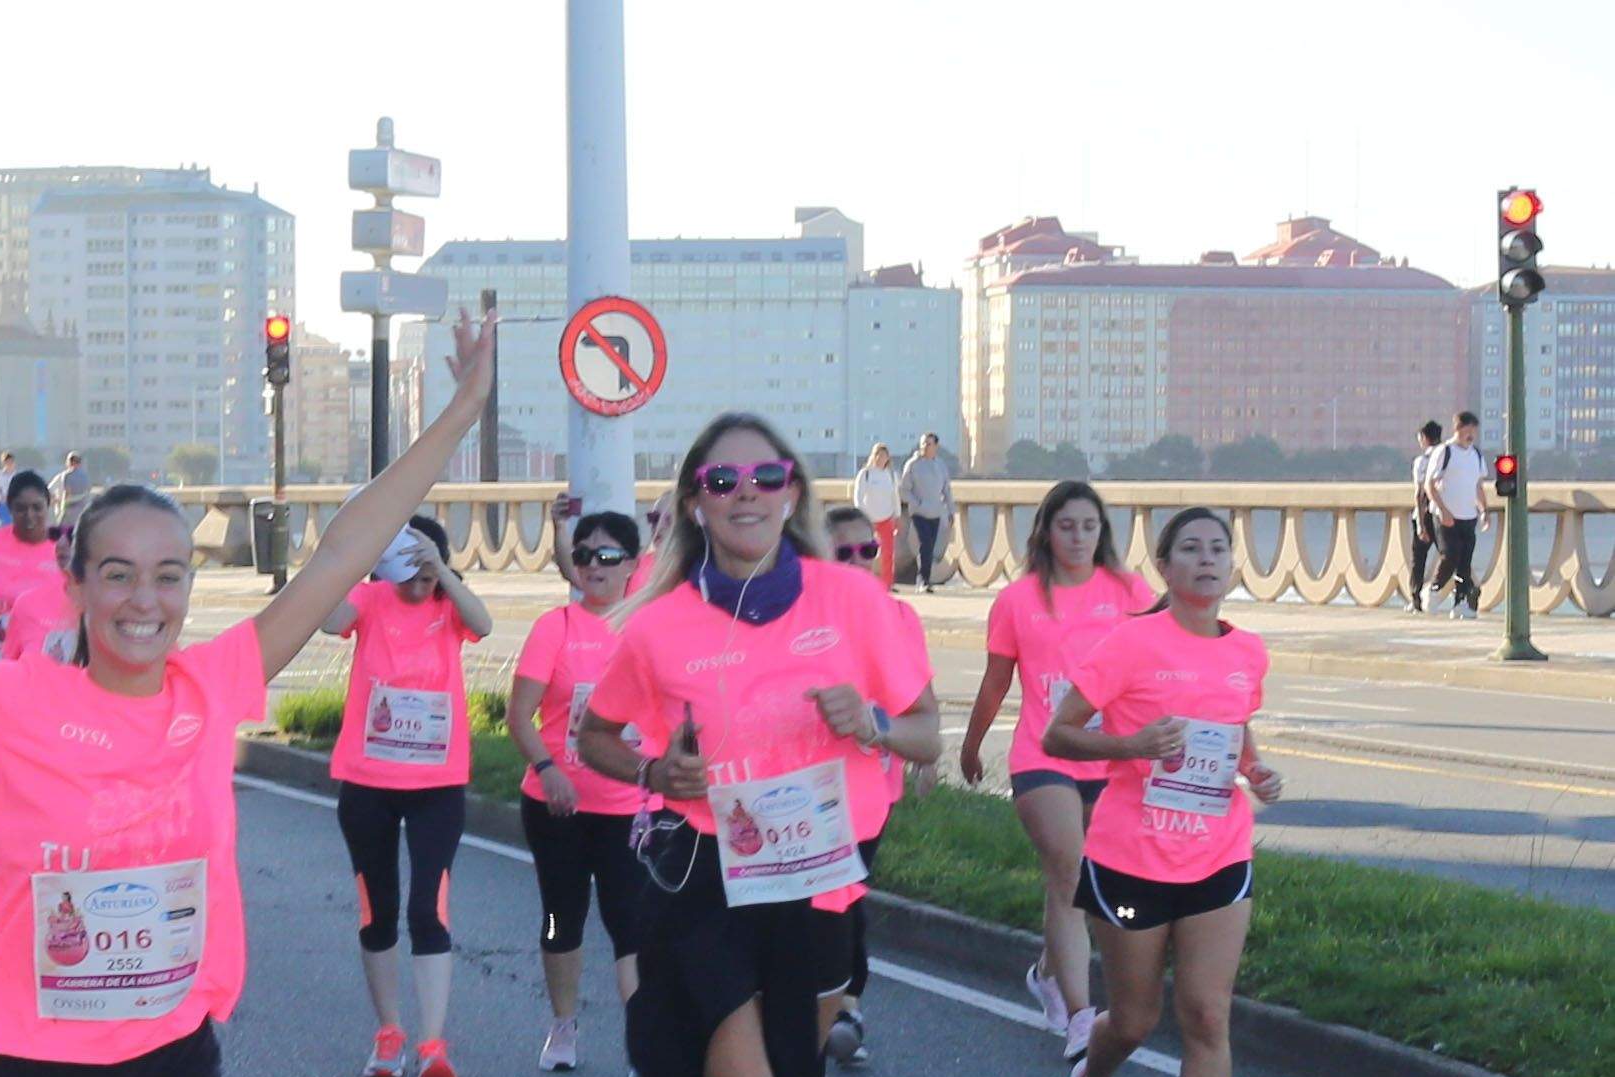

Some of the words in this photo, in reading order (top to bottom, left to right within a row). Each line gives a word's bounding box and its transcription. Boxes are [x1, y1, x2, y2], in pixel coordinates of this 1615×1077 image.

[1187, 756, 1218, 773] 016
[766, 820, 811, 844] 016
[40, 841, 91, 872] TU
[95, 929, 153, 952] 016
[106, 959, 144, 971] 2552
